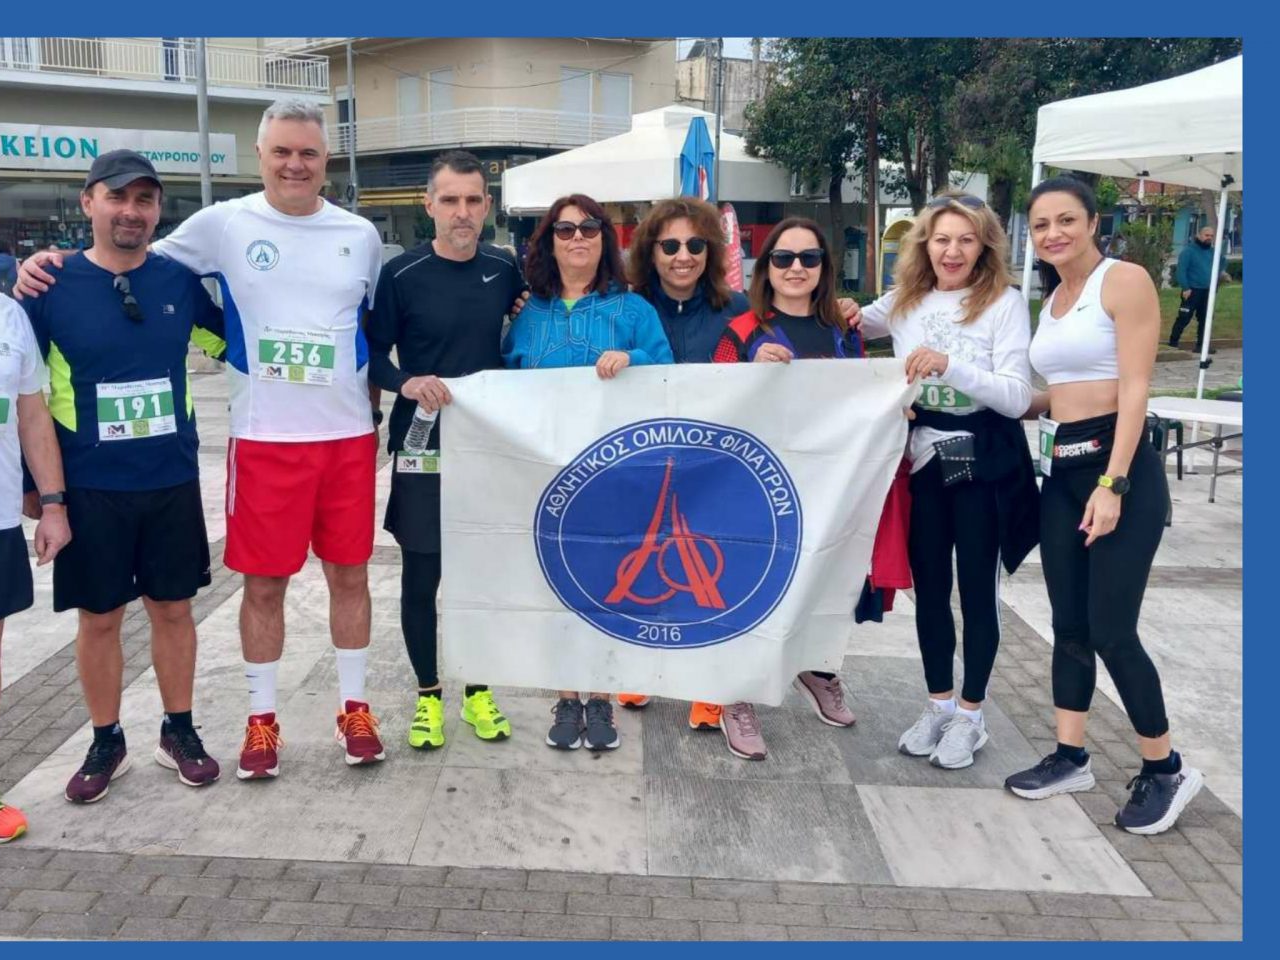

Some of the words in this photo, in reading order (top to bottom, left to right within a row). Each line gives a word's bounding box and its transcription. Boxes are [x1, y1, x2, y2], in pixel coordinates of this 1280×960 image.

[272, 341, 321, 366] 256
[114, 393, 162, 421] 191
[545, 437, 630, 517] ΑΘΛΗΤΙΚΟΣ
[632, 426, 717, 448] ΟΜΙΛΟΣ
[720, 434, 794, 517] ΦΙΛΙΑΤΡΩΝ
[636, 624, 682, 642] 2016
